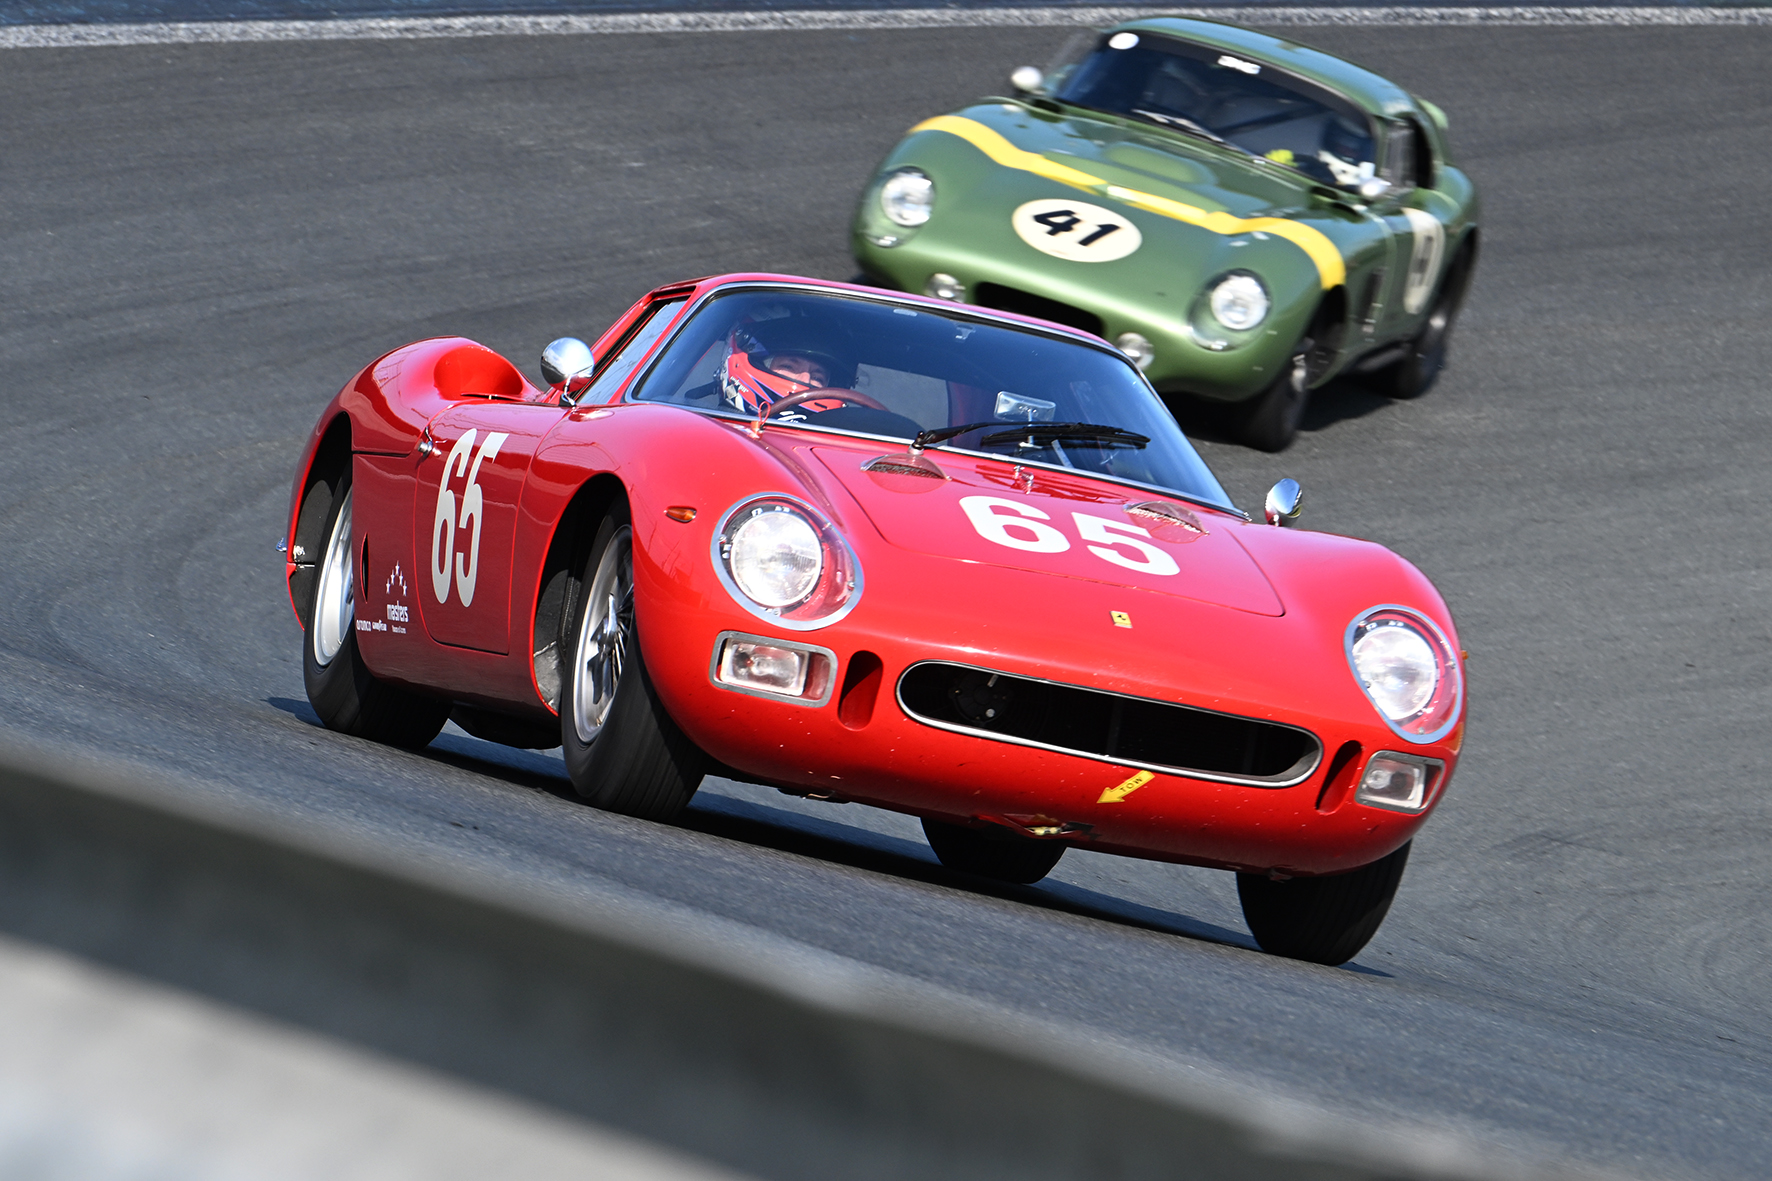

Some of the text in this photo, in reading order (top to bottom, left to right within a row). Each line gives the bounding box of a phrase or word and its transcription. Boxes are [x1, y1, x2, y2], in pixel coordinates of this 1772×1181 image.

[1032, 209, 1121, 247] 41
[431, 428, 510, 608] 65
[959, 495, 1181, 576] 65
[387, 600, 409, 622] masters
[1119, 777, 1143, 792] TOW
